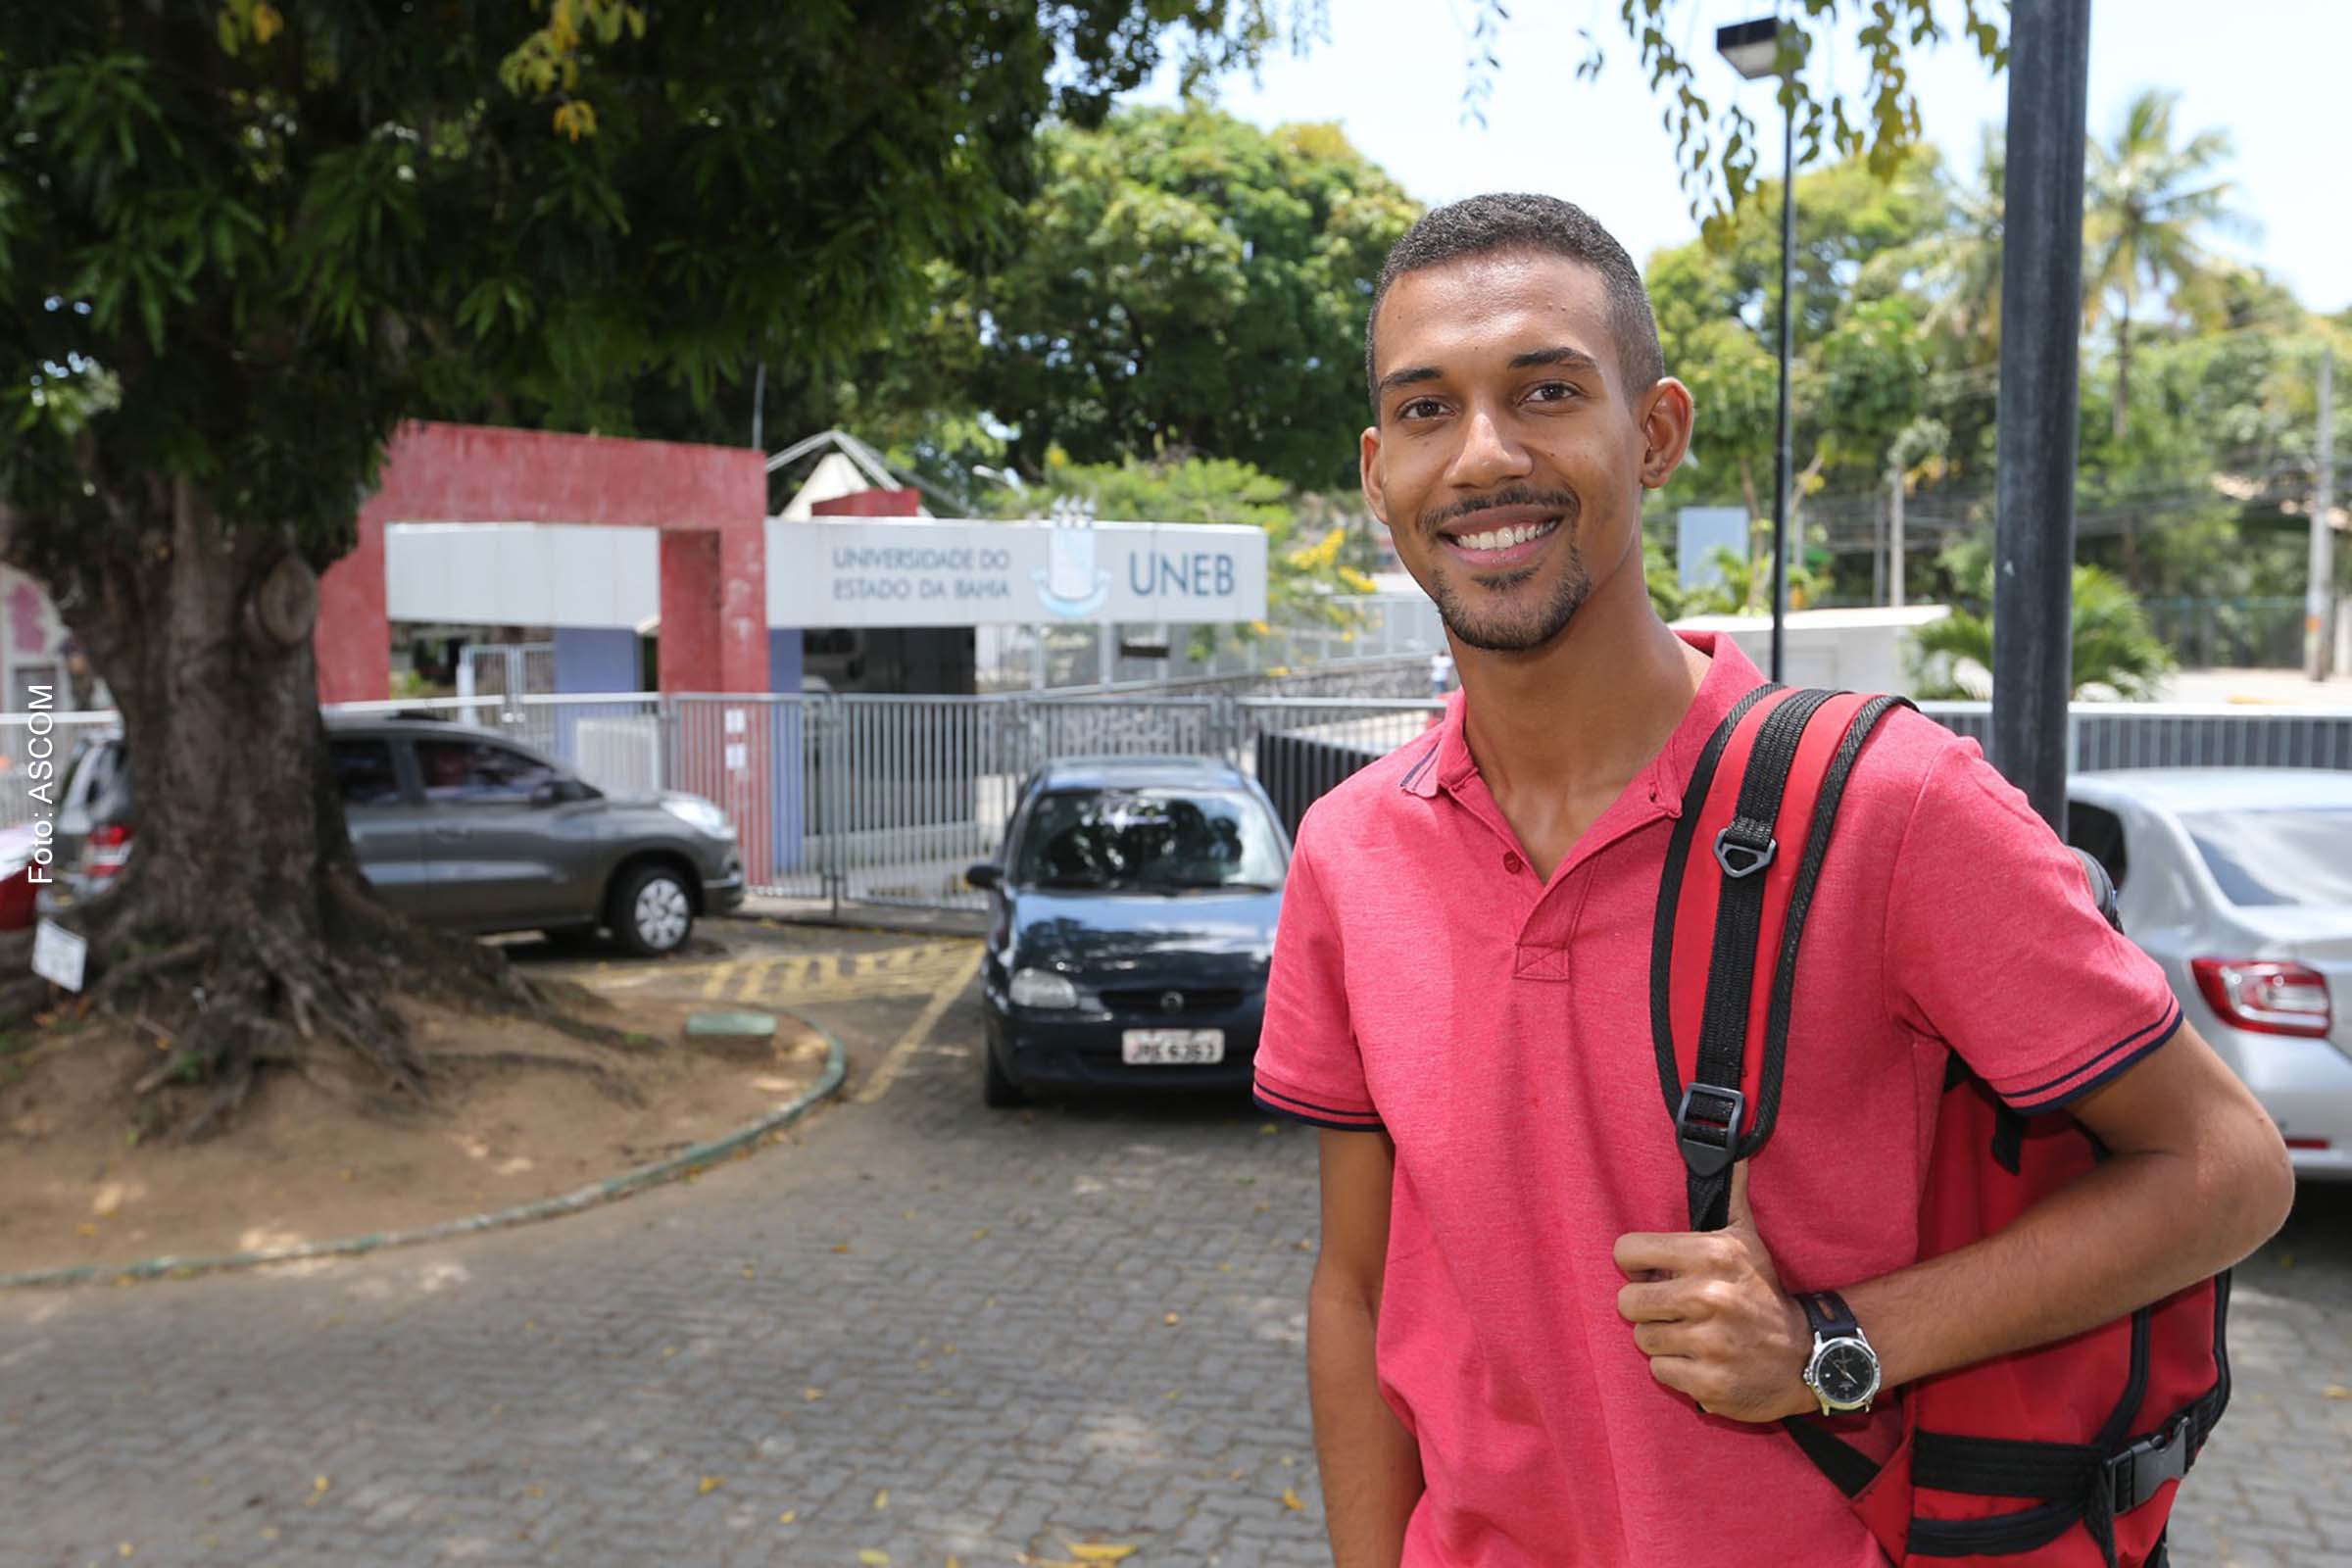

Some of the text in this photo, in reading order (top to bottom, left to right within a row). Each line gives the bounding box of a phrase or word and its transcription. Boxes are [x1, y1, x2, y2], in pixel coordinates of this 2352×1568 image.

[832, 548, 1010, 570] UNIVERSIDADE DO
[1130, 552, 1236, 597] UNEB
[832, 578, 1010, 601] ESTADO DA BAHIA
